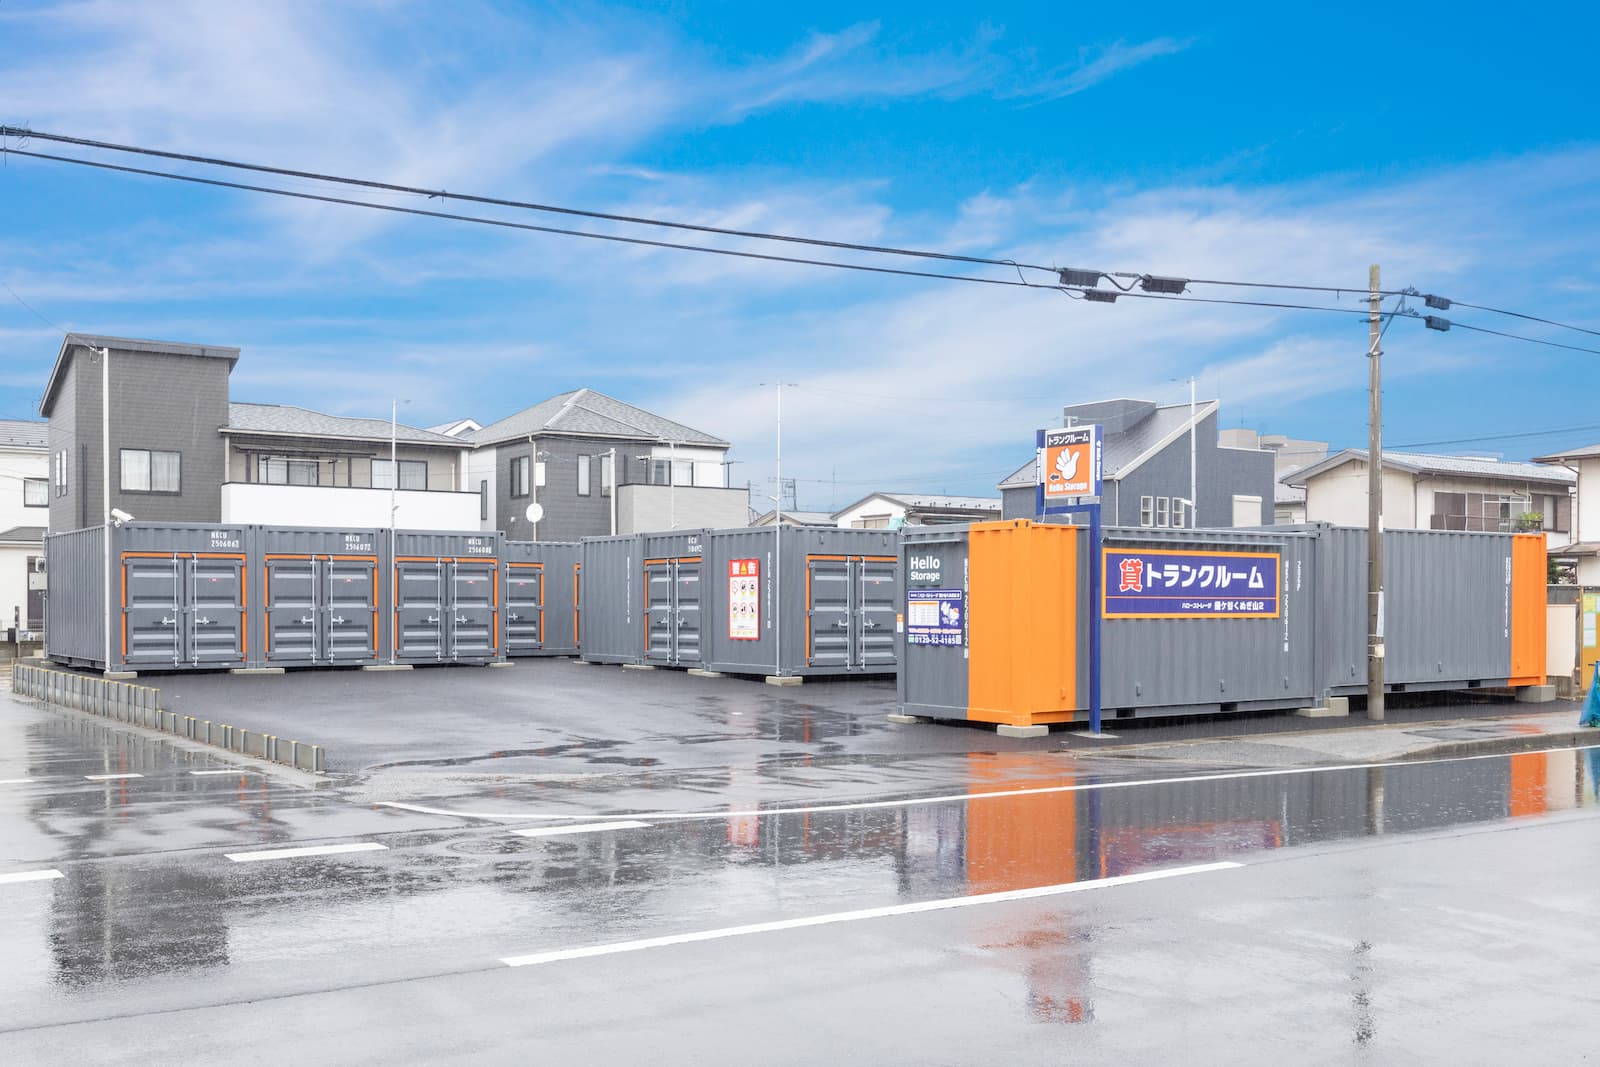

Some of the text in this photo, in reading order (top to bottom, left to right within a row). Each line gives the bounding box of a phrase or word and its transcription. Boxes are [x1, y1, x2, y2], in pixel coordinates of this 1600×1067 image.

[1048, 433, 1089, 446] トランクルーム
[910, 556, 940, 569] Hello
[910, 571, 940, 581] Storage
